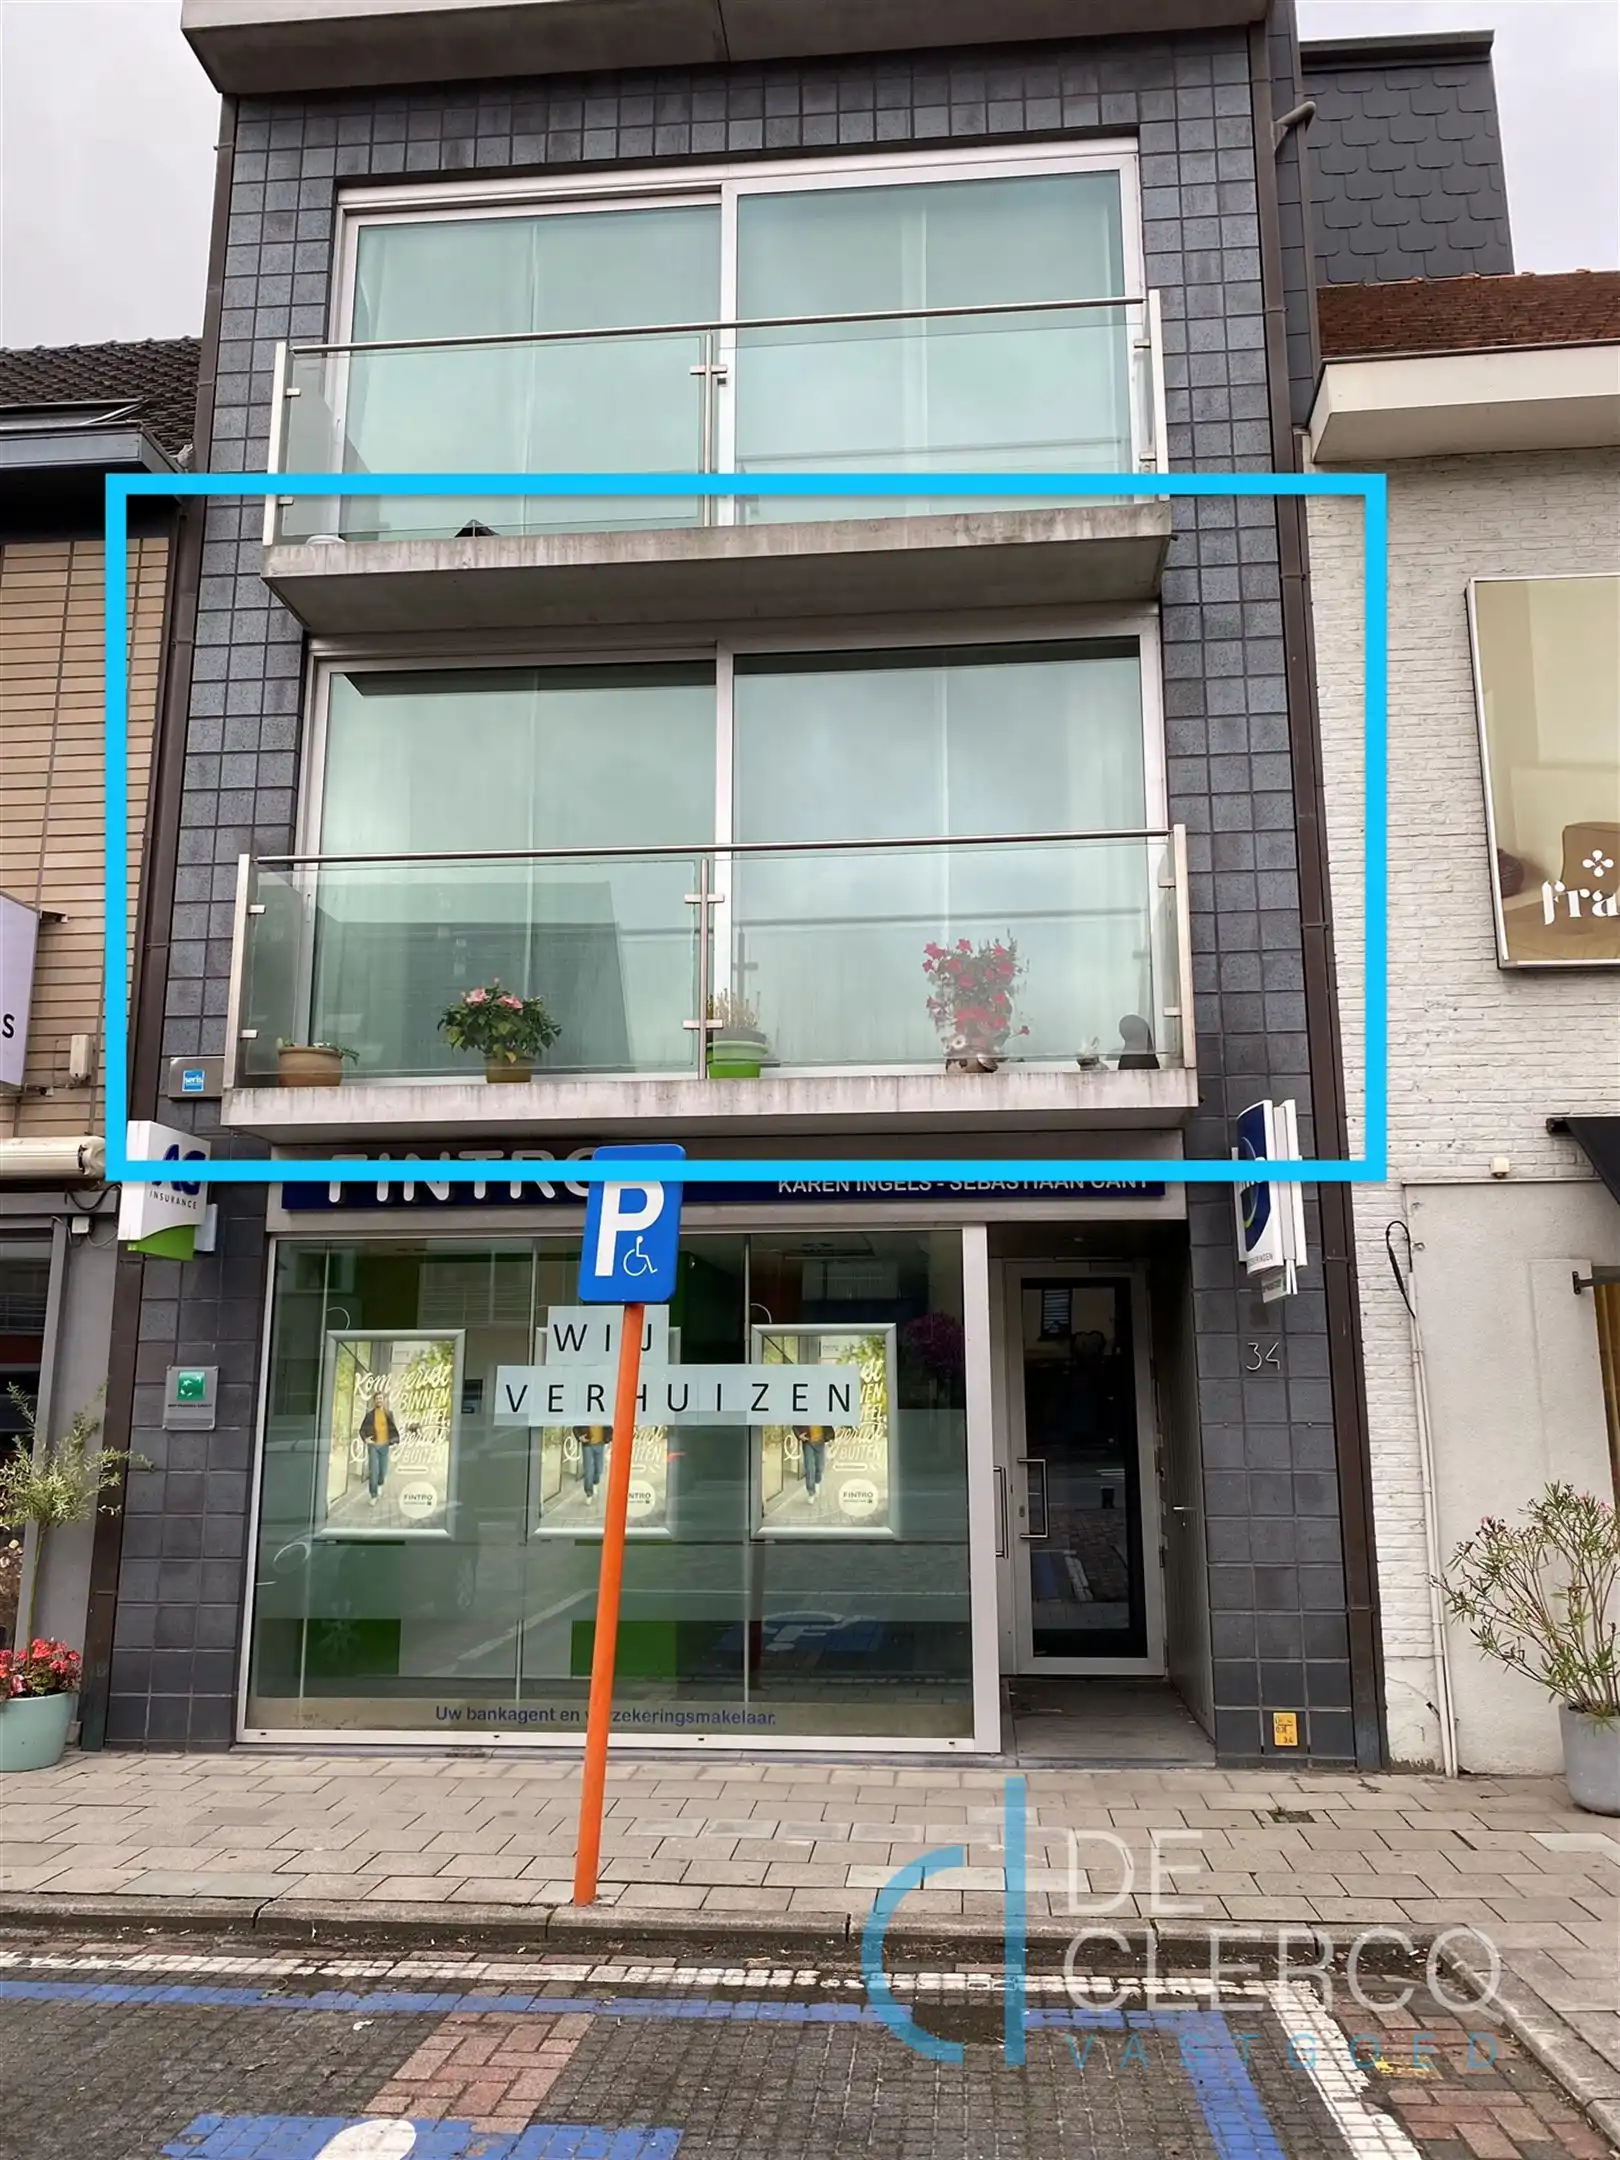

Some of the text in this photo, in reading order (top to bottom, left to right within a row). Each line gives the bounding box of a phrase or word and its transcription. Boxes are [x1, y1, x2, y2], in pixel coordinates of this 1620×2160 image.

[778, 1180, 849, 1192] KAREN
[856, 1180, 931, 1191] INGELS
[149, 1190, 197, 1209] INSURANCE
[594, 1180, 665, 1276] P
[553, 1324, 653, 1351] WIJ
[1246, 1342, 1280, 1371] 34
[400, 1388, 450, 1411] BINNEN
[506, 1383, 850, 1412] VERHUIZEN
[436, 1706, 776, 1727] Uw bankagent en zekeringsmakelaar.
